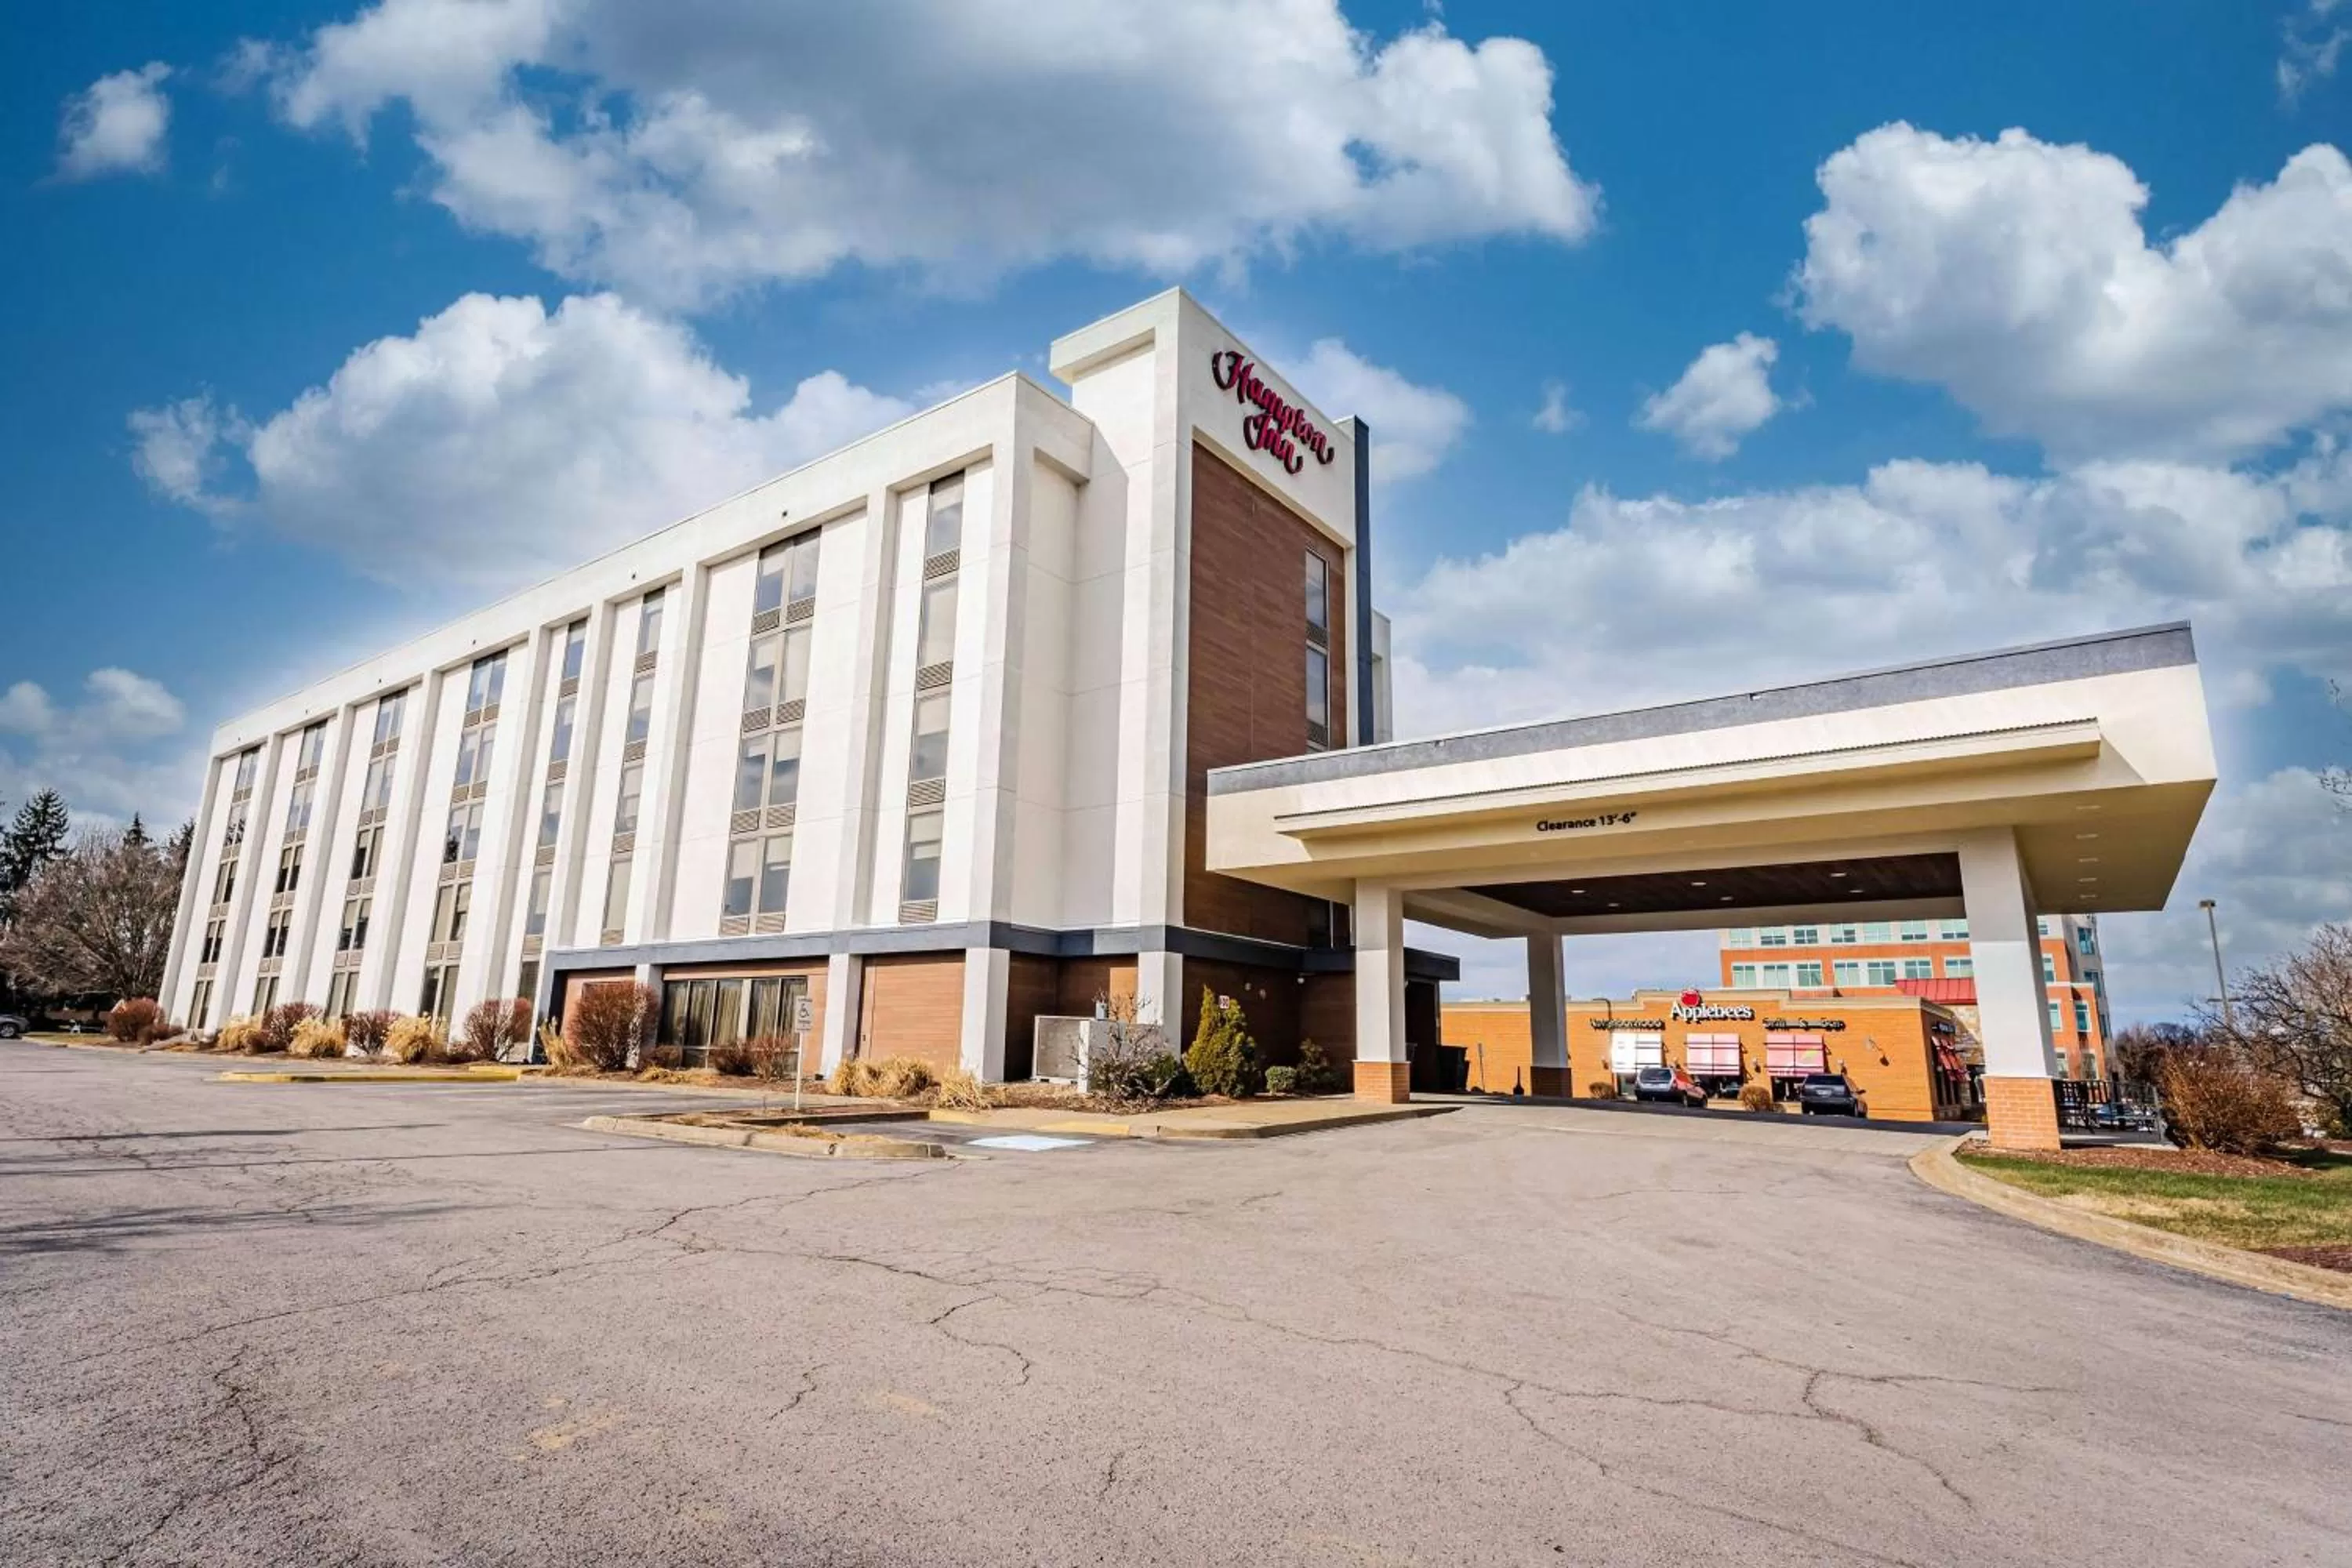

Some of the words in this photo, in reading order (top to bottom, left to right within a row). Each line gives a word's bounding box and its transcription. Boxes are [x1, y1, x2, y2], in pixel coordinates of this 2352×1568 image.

[1212, 350, 1334, 464] Hampton
[1243, 413, 1303, 474] Inn
[1537, 818, 1596, 831] Clearance
